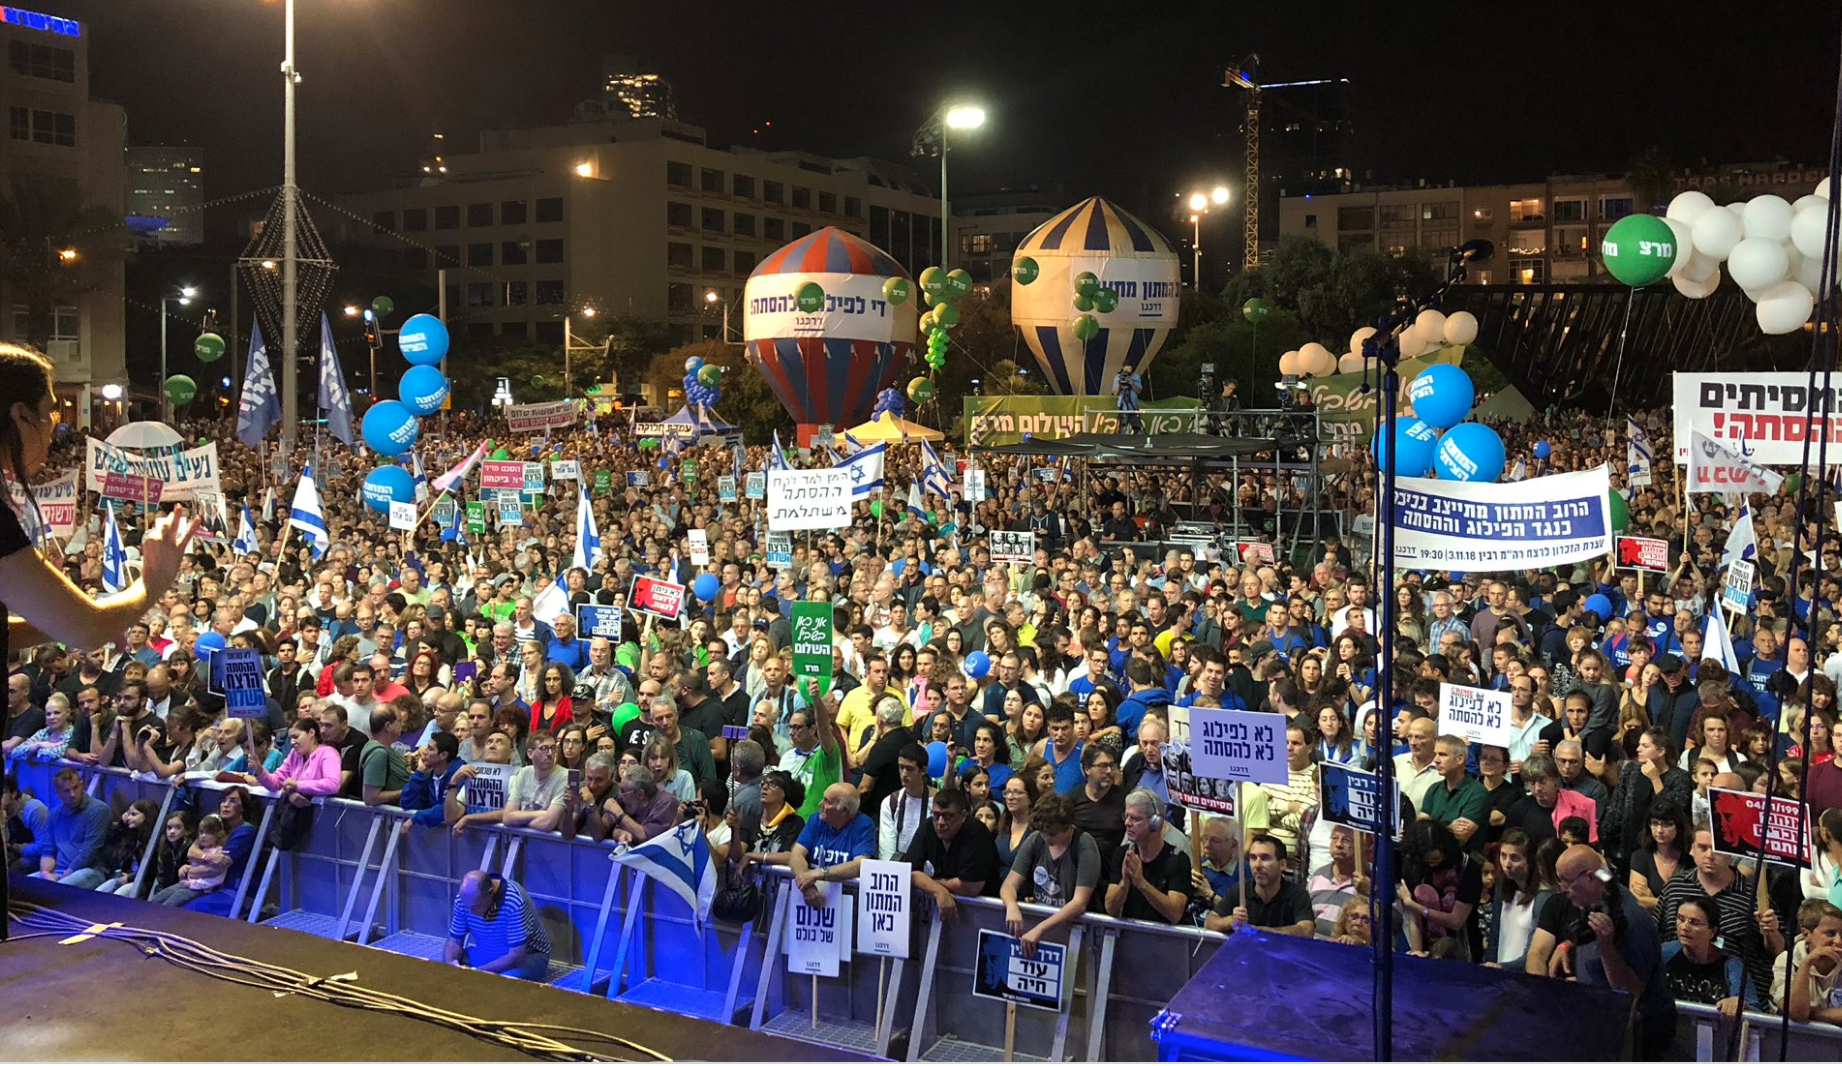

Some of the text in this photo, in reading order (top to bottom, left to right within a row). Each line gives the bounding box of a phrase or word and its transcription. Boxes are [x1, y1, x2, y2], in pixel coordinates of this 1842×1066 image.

[1639, 240, 1672, 258] מרצ
[871, 299, 886, 318] די
[784, 486, 842, 500] ההסתה
[774, 505, 847, 519] משתלמת
[1394, 491, 1589, 521] הרוב המתון מתייצב בכיכ
[1403, 510, 1572, 537] כנגד הפילוג וההסתה
[768, 543, 789, 552] הרצח
[1527, 546, 1550, 558] לרצח
[1553, 541, 1580, 556] הזכרון
[1583, 539, 1605, 551] עצרת
[1420, 549, 1443, 560] 19:30
[1449, 551, 1476, 561] 3.11.18
[1479, 552, 1497, 561] רבין
[652, 585, 681, 597] לא ניתן
[1729, 576, 1749, 593] הרצח
[795, 615, 828, 630] אני כאן
[593, 627, 610, 635] היום
[797, 627, 827, 641] בשביל
[795, 642, 831, 655] השלום
[226, 662, 256, 673] ההסתה
[805, 664, 820, 672] מרצ
[226, 673, 261, 689] הרצח
[226, 689, 267, 707] השלום
[1487, 701, 1501, 714] לא
[1449, 709, 1501, 728] לא להסתה
[1203, 720, 1248, 740] לפילוג
[1254, 725, 1273, 743] לא
[1204, 740, 1274, 761] לא להסתה
[493, 767, 501, 776] לא
[1229, 765, 1248, 773] דרכנו
[472, 778, 503, 790] ההסתה
[1348, 775, 1368, 788] רבין
[469, 788, 504, 808] הרצח
[1201, 798, 1233, 811] מסיתים
[1356, 791, 1376, 804] וד
[1357, 806, 1374, 818] יה
[870, 873, 899, 892] הרוב
[866, 892, 902, 912] המתון
[796, 904, 835, 928] שלום
[872, 913, 894, 933] כאן
[796, 927, 834, 943] של כולם
[1040, 949, 1060, 962] דרך
[1020, 961, 1048, 978] עוד
[1018, 977, 1046, 993] חיה
